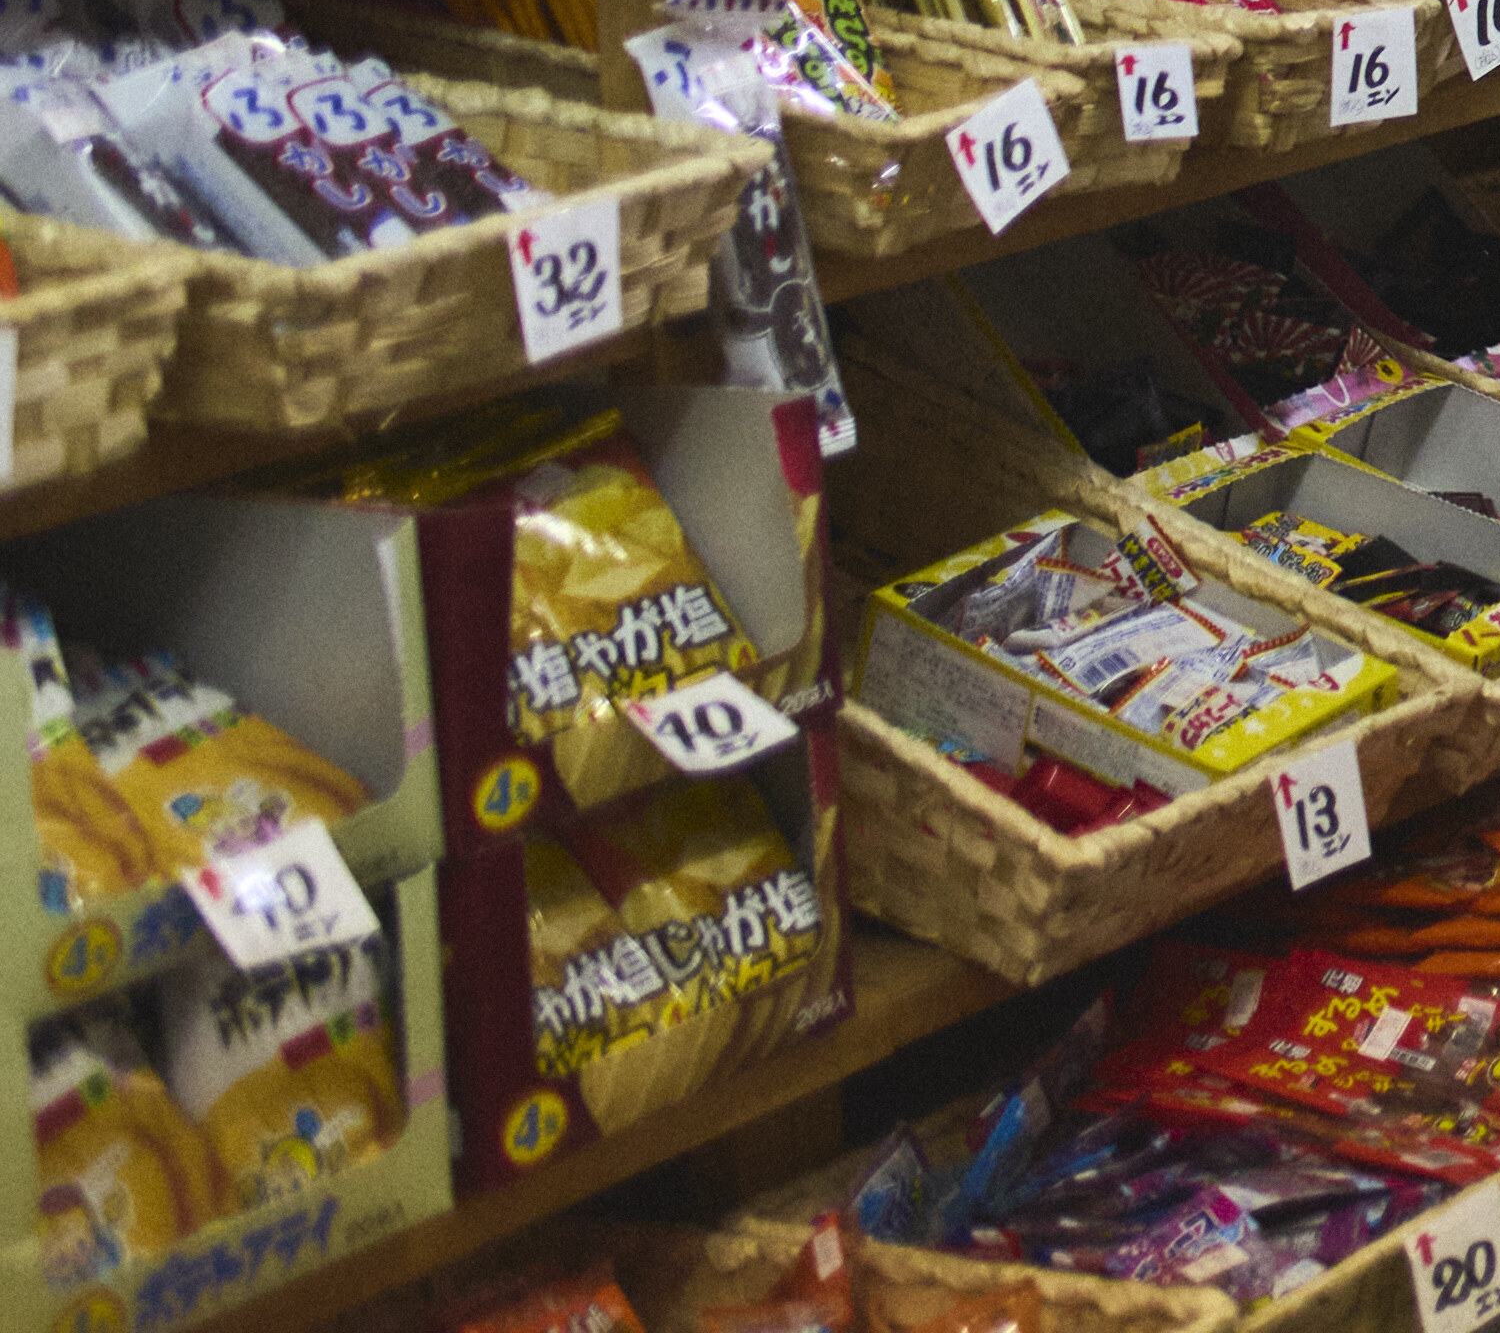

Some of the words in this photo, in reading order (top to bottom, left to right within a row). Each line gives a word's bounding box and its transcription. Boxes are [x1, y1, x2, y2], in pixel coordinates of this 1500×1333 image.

[1134, 72, 1179, 114] 16
[1349, 45, 1388, 93] 16
[1367, 87, 1400, 108] エン
[985, 122, 1033, 192] 16
[532, 240, 606, 316] 32
[657, 701, 743, 754] 10
[1298, 787, 1339, 850] 13
[646, 872, 820, 984] じゃが塩
[1434, 1240, 1498, 1313] 20
